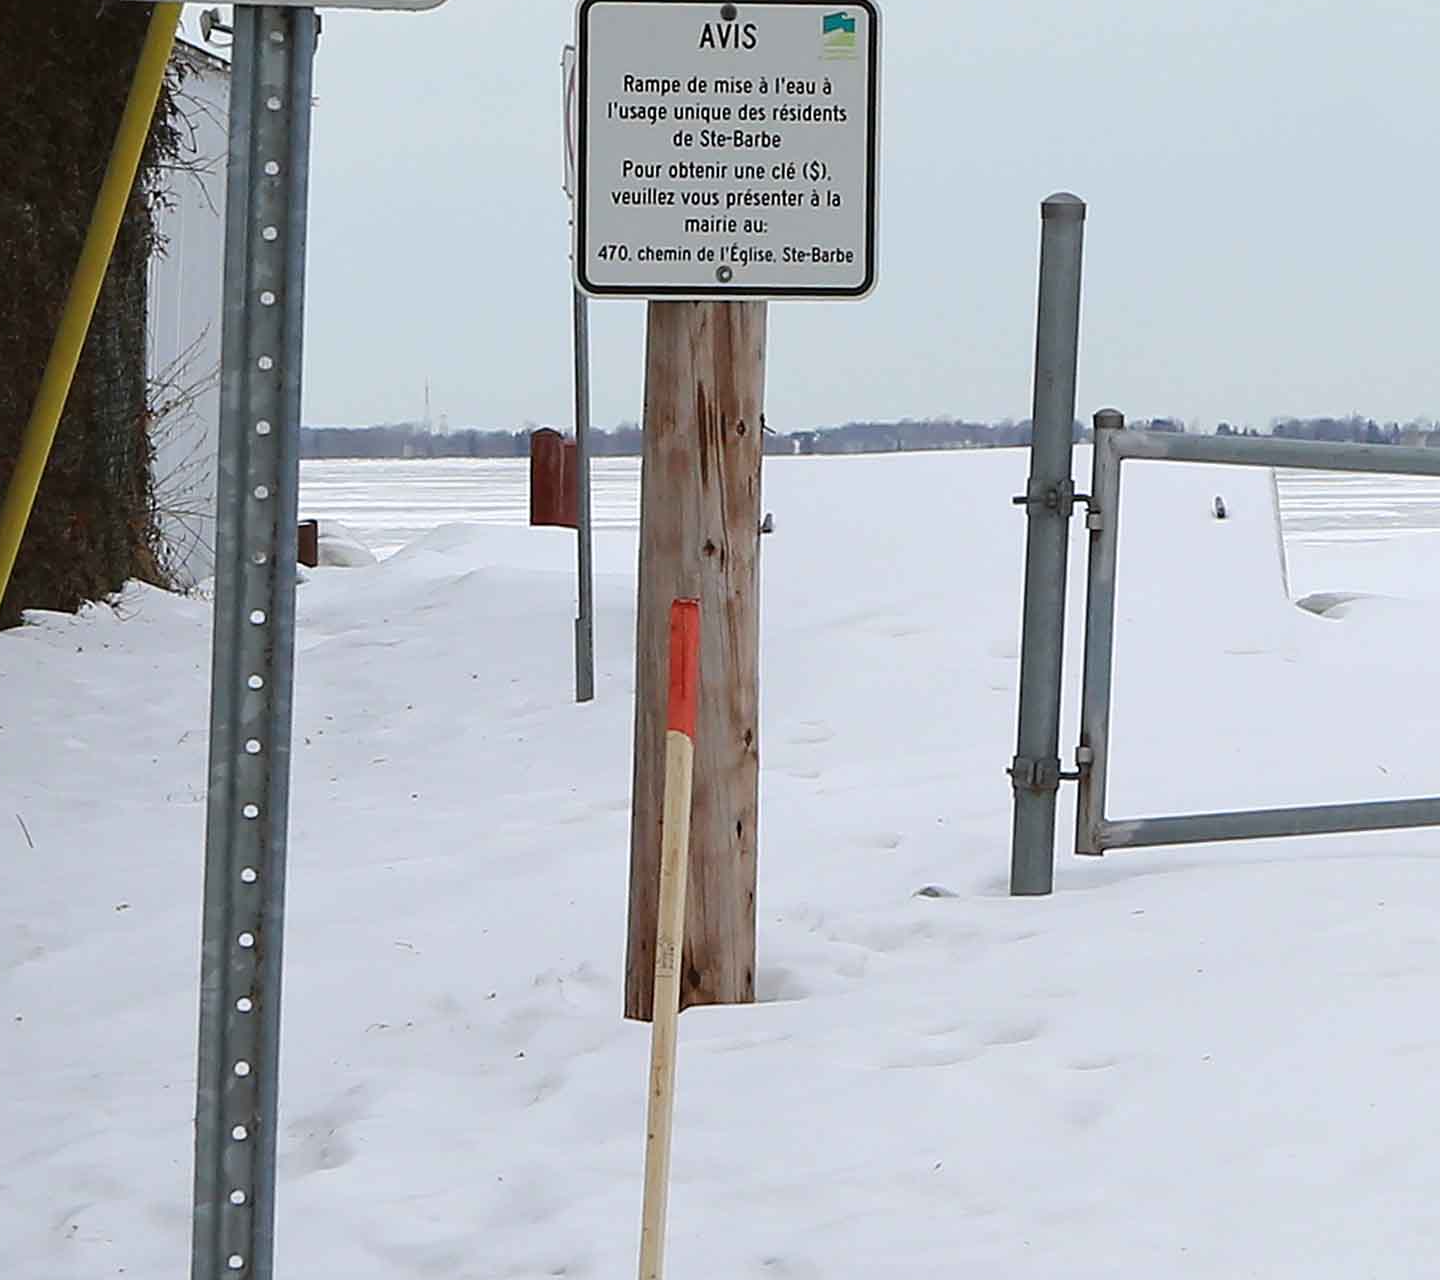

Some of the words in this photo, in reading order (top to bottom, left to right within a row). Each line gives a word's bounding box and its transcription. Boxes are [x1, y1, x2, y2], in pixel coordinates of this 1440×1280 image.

[699, 23, 758, 50] AVIS
[623, 75, 681, 96] Rampe
[687, 76, 707, 93] de
[714, 76, 753, 94] mise
[759, 76, 768, 94] à
[775, 77, 816, 95] l'eau
[822, 77, 832, 95] à
[608, 102, 667, 125] l'usage
[674, 103, 731, 124] unique
[738, 104, 766, 121] des
[773, 104, 847, 122] résidents
[673, 130, 693, 147] de
[700, 129, 781, 148] Ste-Barbe
[622, 160, 662, 179] Pour
[668, 160, 728, 179] obtenir
[734, 164, 765, 179] une
[772, 162, 796, 180] clé
[611, 188, 675, 205] veuillez
[681, 191, 719, 206] vous
[726, 189, 804, 209] présenter
[810, 189, 819, 206] à
[827, 190, 841, 207] la
[684, 215, 737, 233] mairie
[743, 218, 768, 233] au:
[637, 246, 691, 262] chemin
[696, 246, 715, 263] de
[782, 246, 854, 264] Ste-Barbe
